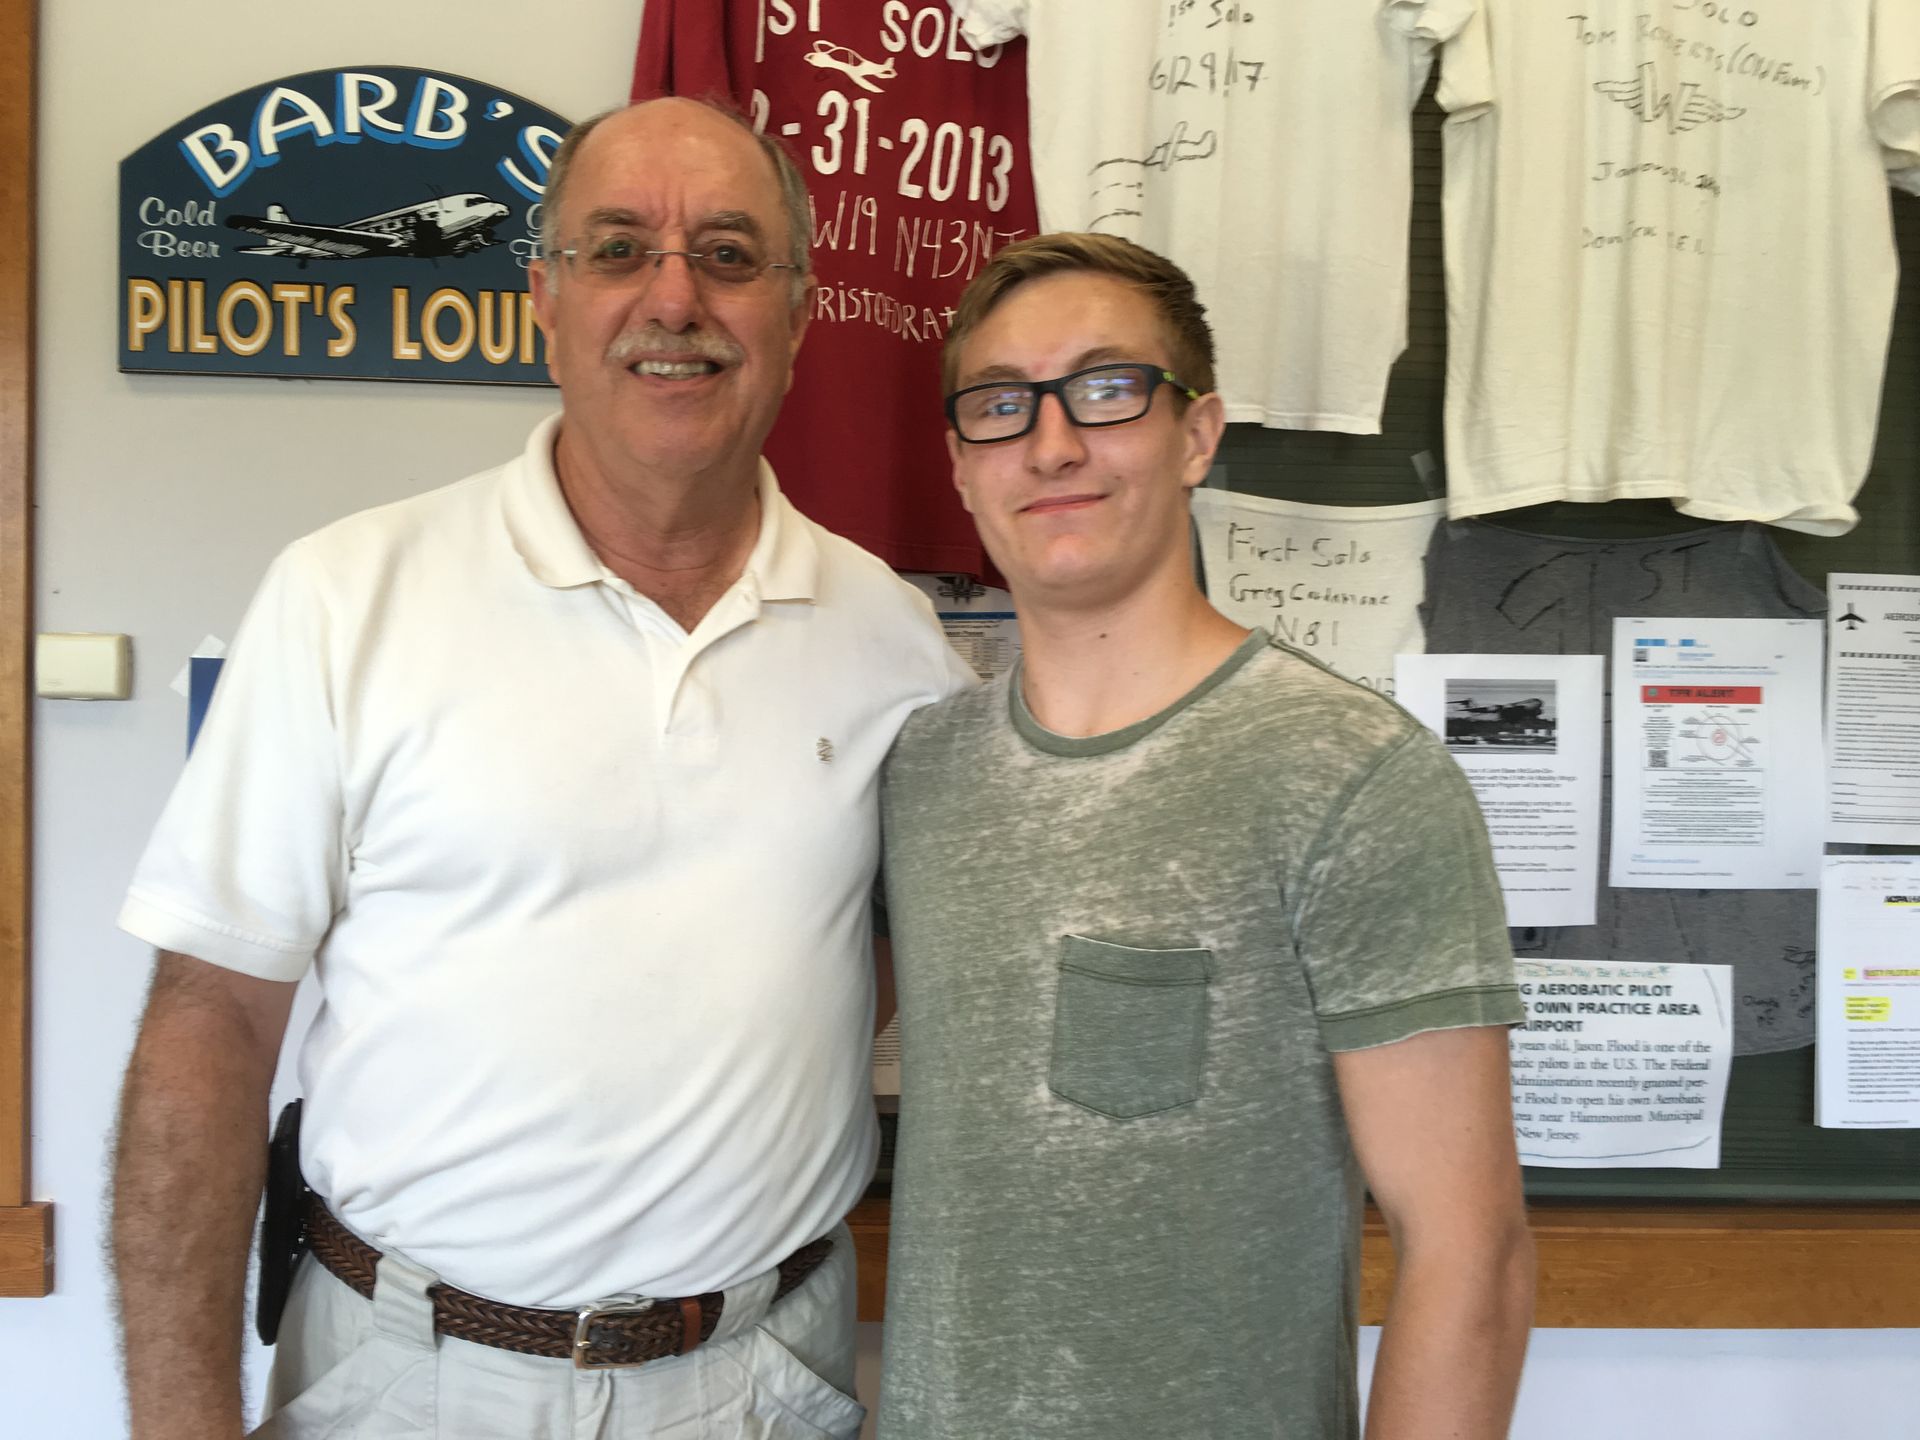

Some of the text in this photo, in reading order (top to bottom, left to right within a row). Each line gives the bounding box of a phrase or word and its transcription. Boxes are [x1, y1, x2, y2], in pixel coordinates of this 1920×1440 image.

[1205, 0, 1254, 29] Solo
[179, 72, 566, 199] BARB'S
[138, 196, 217, 228] Cold
[136, 229, 221, 258] Beer
[127, 277, 358, 358] PILOT'S
[1227, 522, 1372, 568] First Solo
[1229, 572, 1285, 609] Greg
[1271, 613, 1340, 647] N81
[1517, 983, 1673, 998] G AEROBATIC PILOT
[1534, 1002, 1572, 1015] OWN
[1577, 1002, 1652, 1015] PRACTICE
[1657, 1004, 1702, 1016] AREA
[1518, 1020, 1584, 1032] AIRPORT
[1573, 1040, 1603, 1054] Jason
[1607, 1040, 1641, 1052] Flood
[1691, 1041, 1711, 1053] the
[1643, 1058, 1666, 1071] The
[1670, 1058, 1711, 1071] Federal
[1524, 1093, 1558, 1105] Flood
[1516, 1128, 1543, 1139] New
